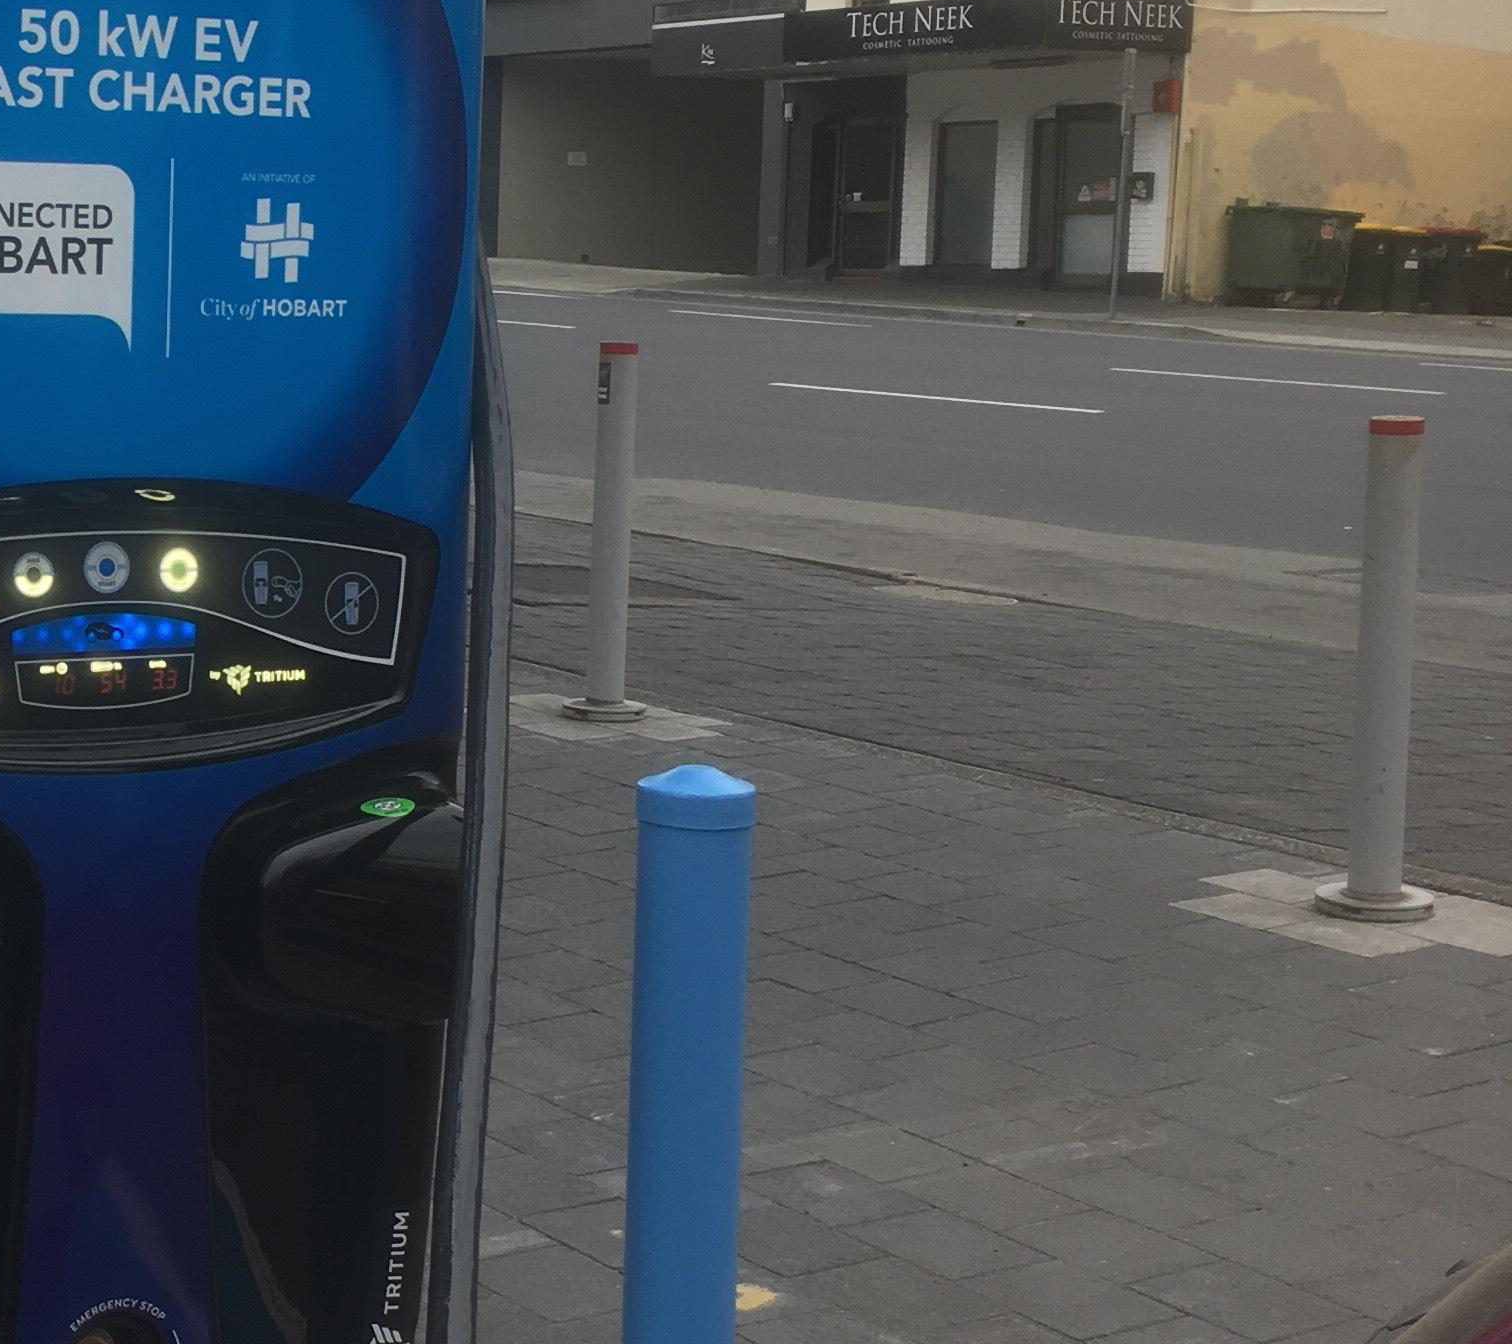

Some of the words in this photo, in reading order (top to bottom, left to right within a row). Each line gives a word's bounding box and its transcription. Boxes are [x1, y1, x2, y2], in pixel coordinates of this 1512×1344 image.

[18, 8, 80, 55] 50
[98, 9, 178, 59] kW
[195, 17, 259, 63] EV
[862, 39, 902, 50] COSMETIC
[907, 36, 954, 48] TATTOOING
[88, 68, 312, 119] CHARGER
[200, 297, 235, 321] City
[239, 298, 261, 321] of
[262, 299, 348, 317] HOBART
[254, 669, 306, 683] TRITIUM
[383, 1211, 410, 1315] TRITIUM
[69, 1297, 138, 1332] EMERGENCY
[139, 1300, 167, 1321] STOP
